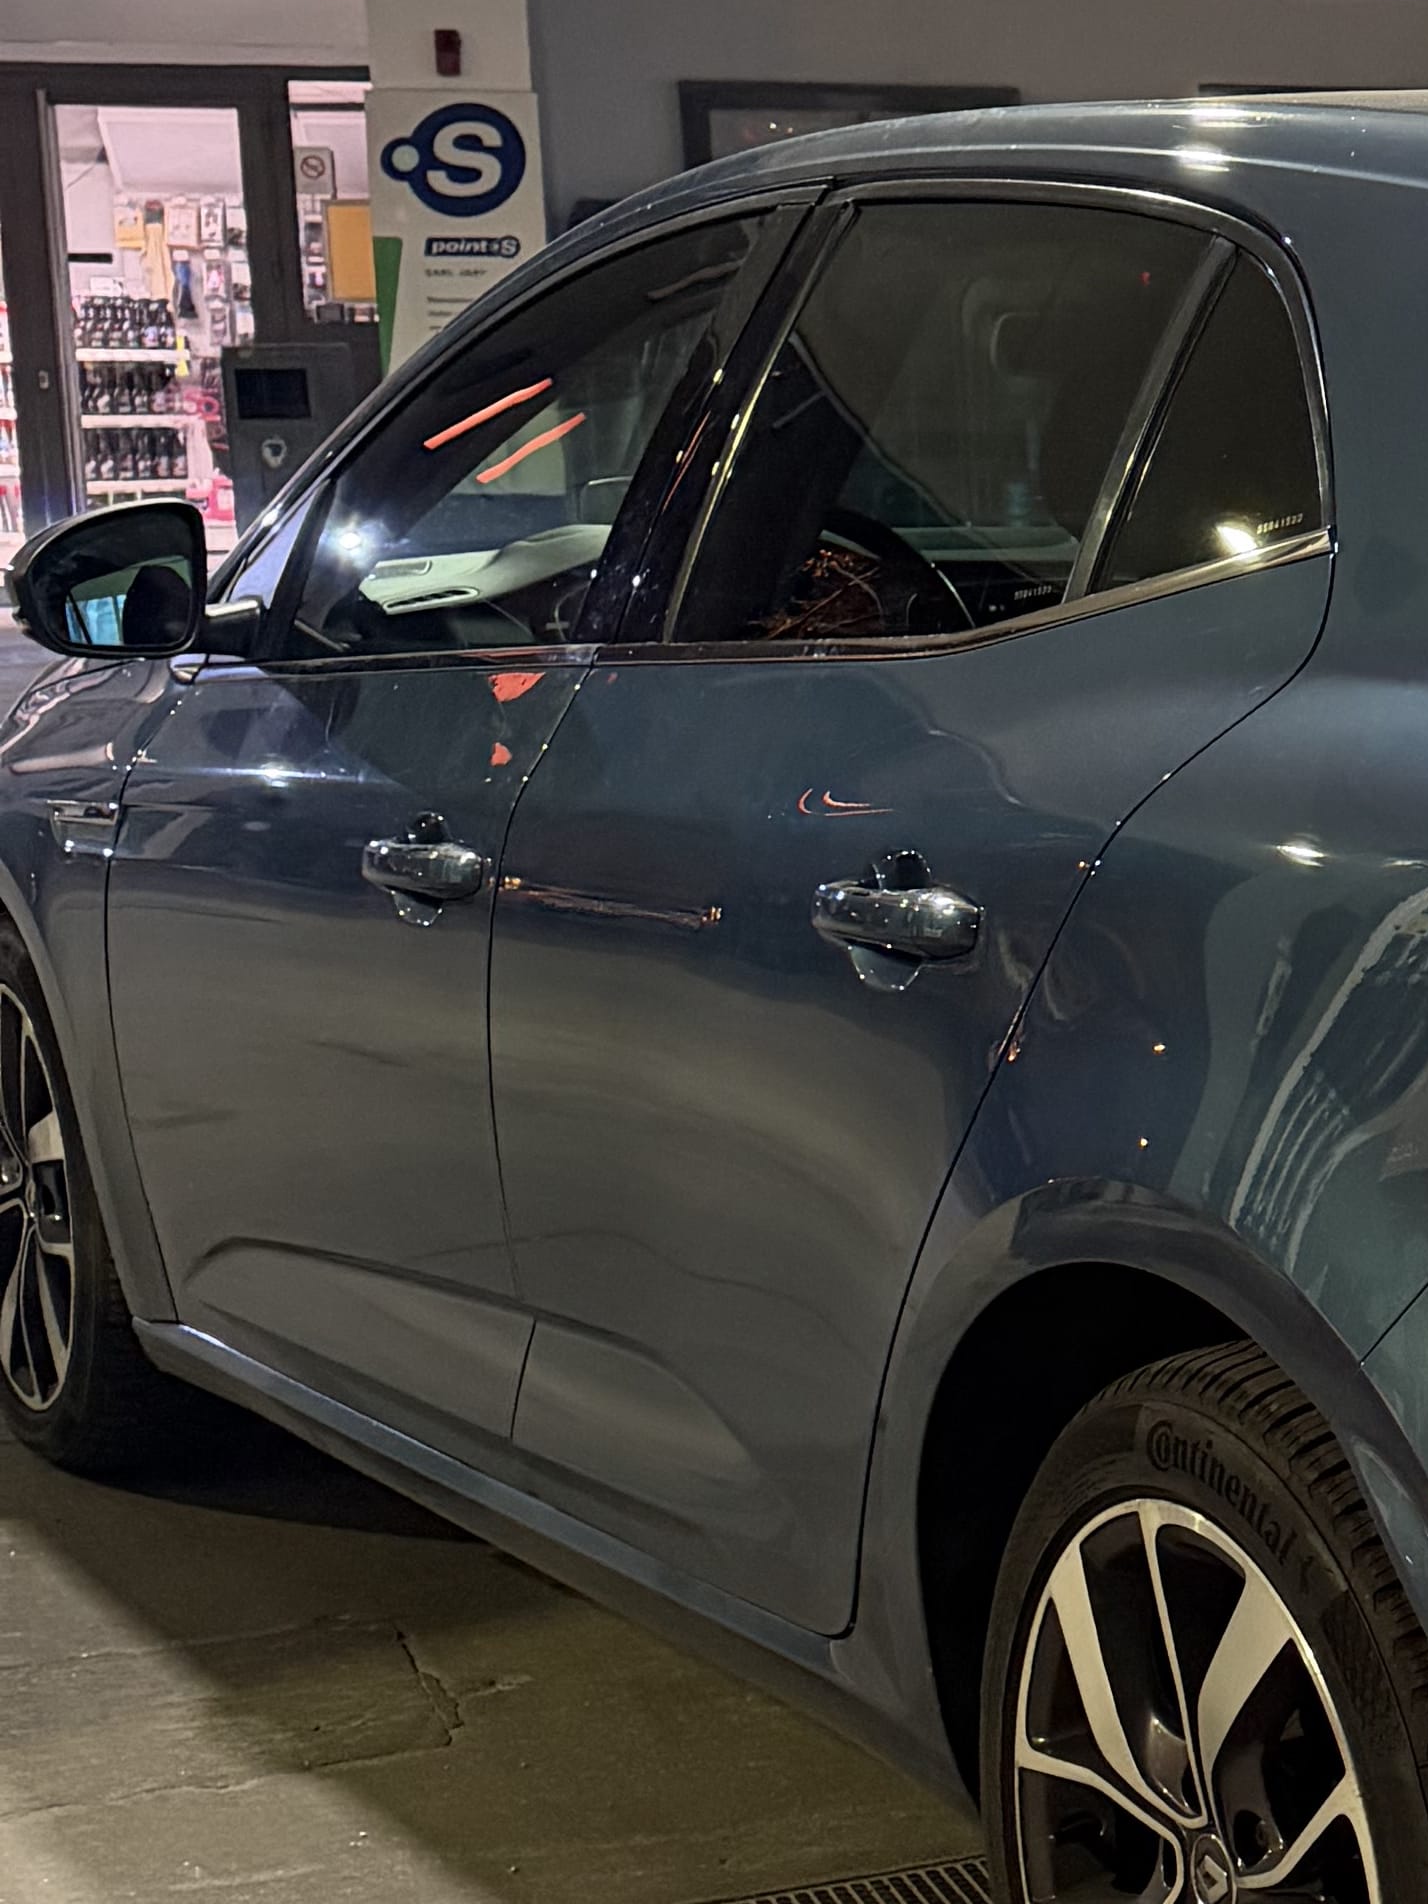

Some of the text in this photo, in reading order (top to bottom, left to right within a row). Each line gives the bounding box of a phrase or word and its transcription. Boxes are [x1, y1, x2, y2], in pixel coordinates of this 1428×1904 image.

[426, 120, 503, 198] S
[431, 239, 492, 255] point
[1147, 1419, 1297, 1565] Continental
